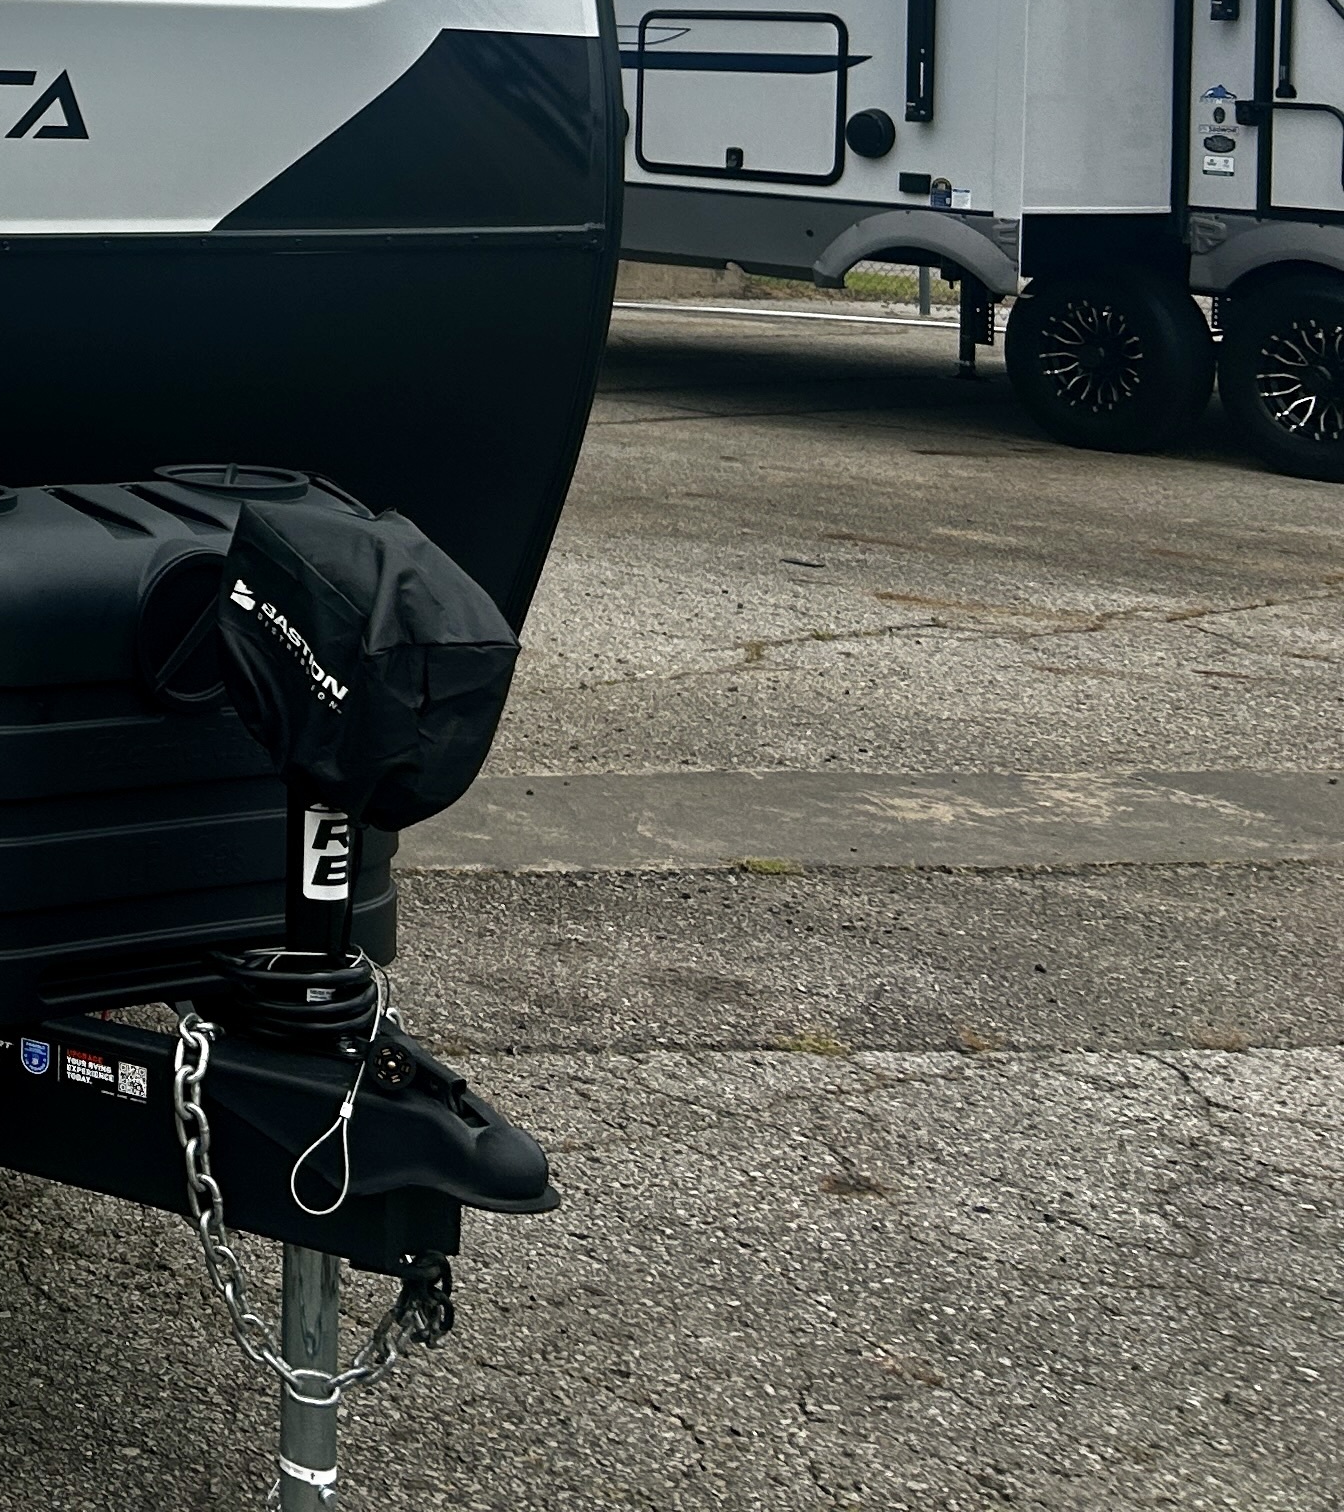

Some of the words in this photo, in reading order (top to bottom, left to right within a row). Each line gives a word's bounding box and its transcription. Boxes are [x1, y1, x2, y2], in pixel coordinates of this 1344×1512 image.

[261, 602, 349, 700] BASTION
[66, 1055, 87, 1068] YOUR
[66, 1063, 115, 1083] EXPERIENCE
